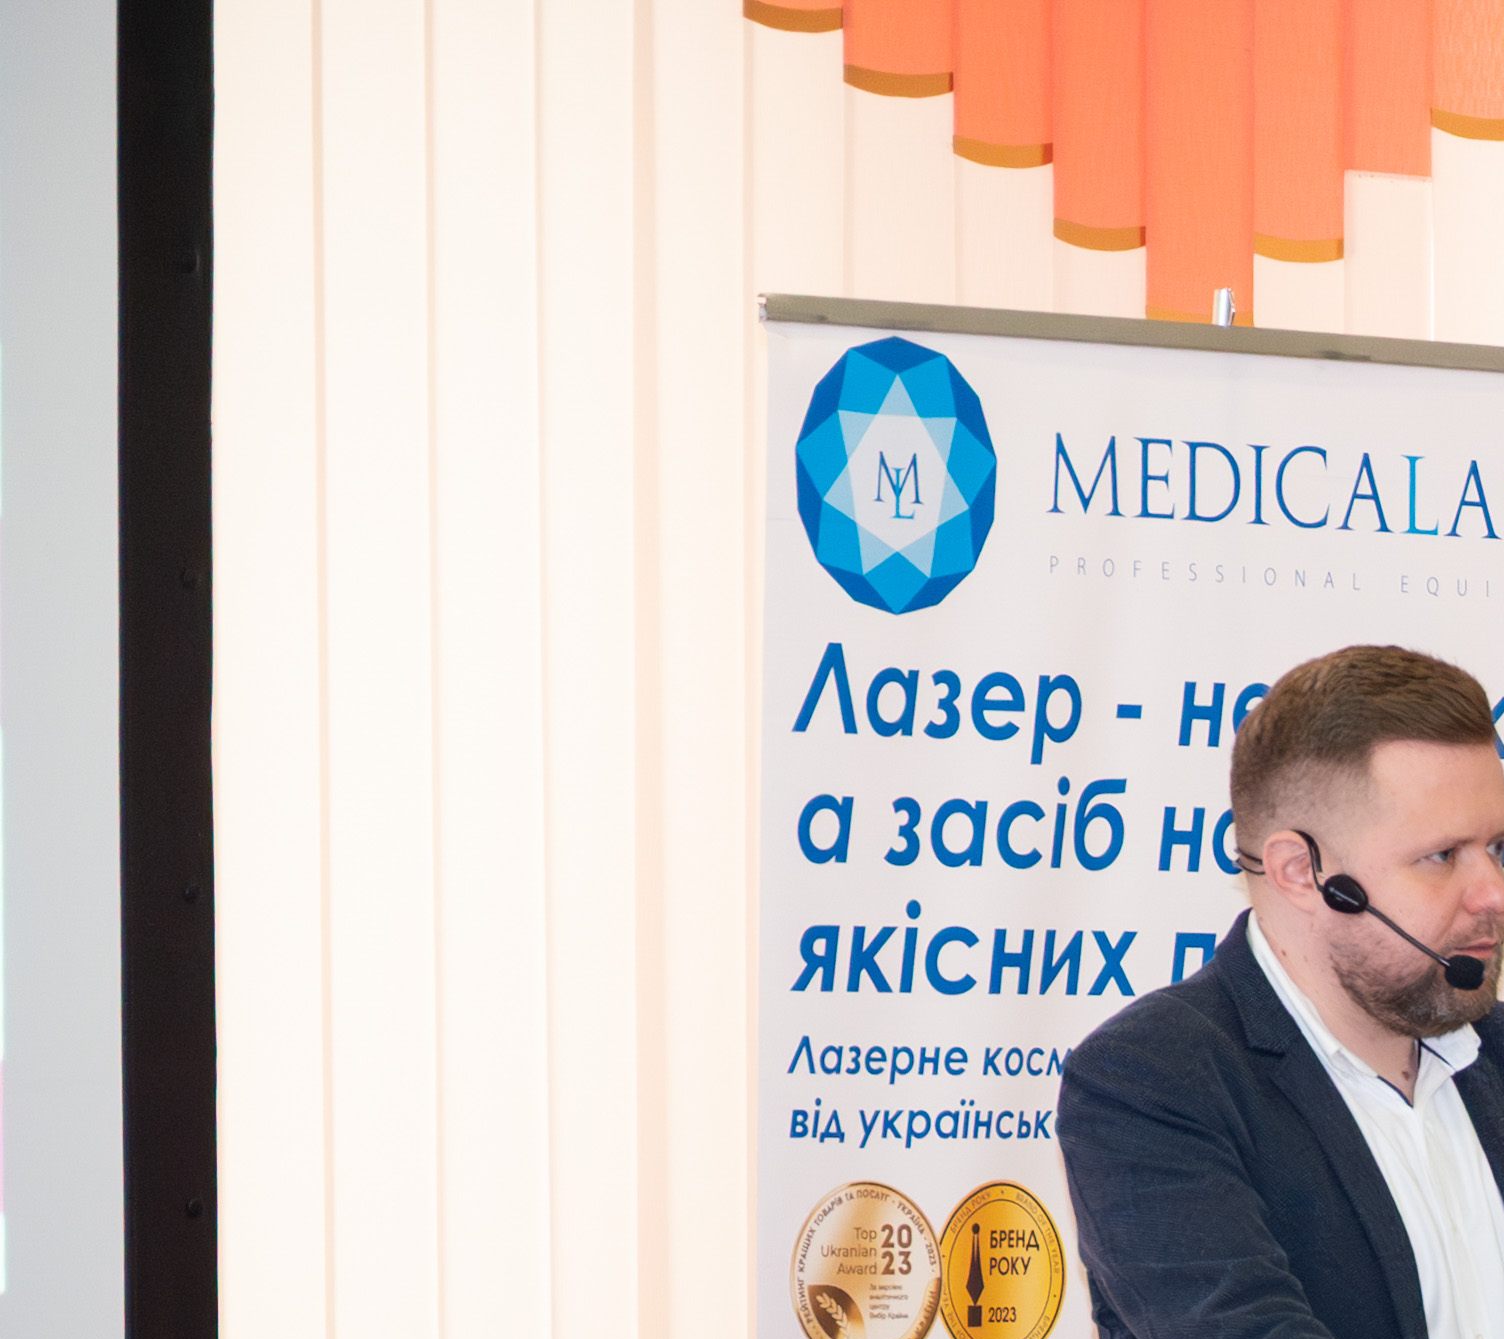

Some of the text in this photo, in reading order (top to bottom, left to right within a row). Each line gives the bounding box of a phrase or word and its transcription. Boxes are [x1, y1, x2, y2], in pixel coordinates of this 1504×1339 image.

[1050, 555, 1363, 591] PROFESSIONAL
[791, 642, 1083, 764] Лазер
[797, 776, 1127, 873] а засіб
[791, 900, 1138, 998] якісних
[787, 1035, 968, 1085] Лазерне
[789, 1098, 1053, 1149] від українськ
[854, 1227, 877, 1241] Top
[881, 1224, 912, 1248] 20
[990, 1230, 1040, 1251] БРЕНД
[836, 1262, 877, 1275] Award
[881, 1251, 912, 1275] 23
[989, 1256, 1031, 1276] РОКУ
[988, 1306, 1017, 1323] 2023
